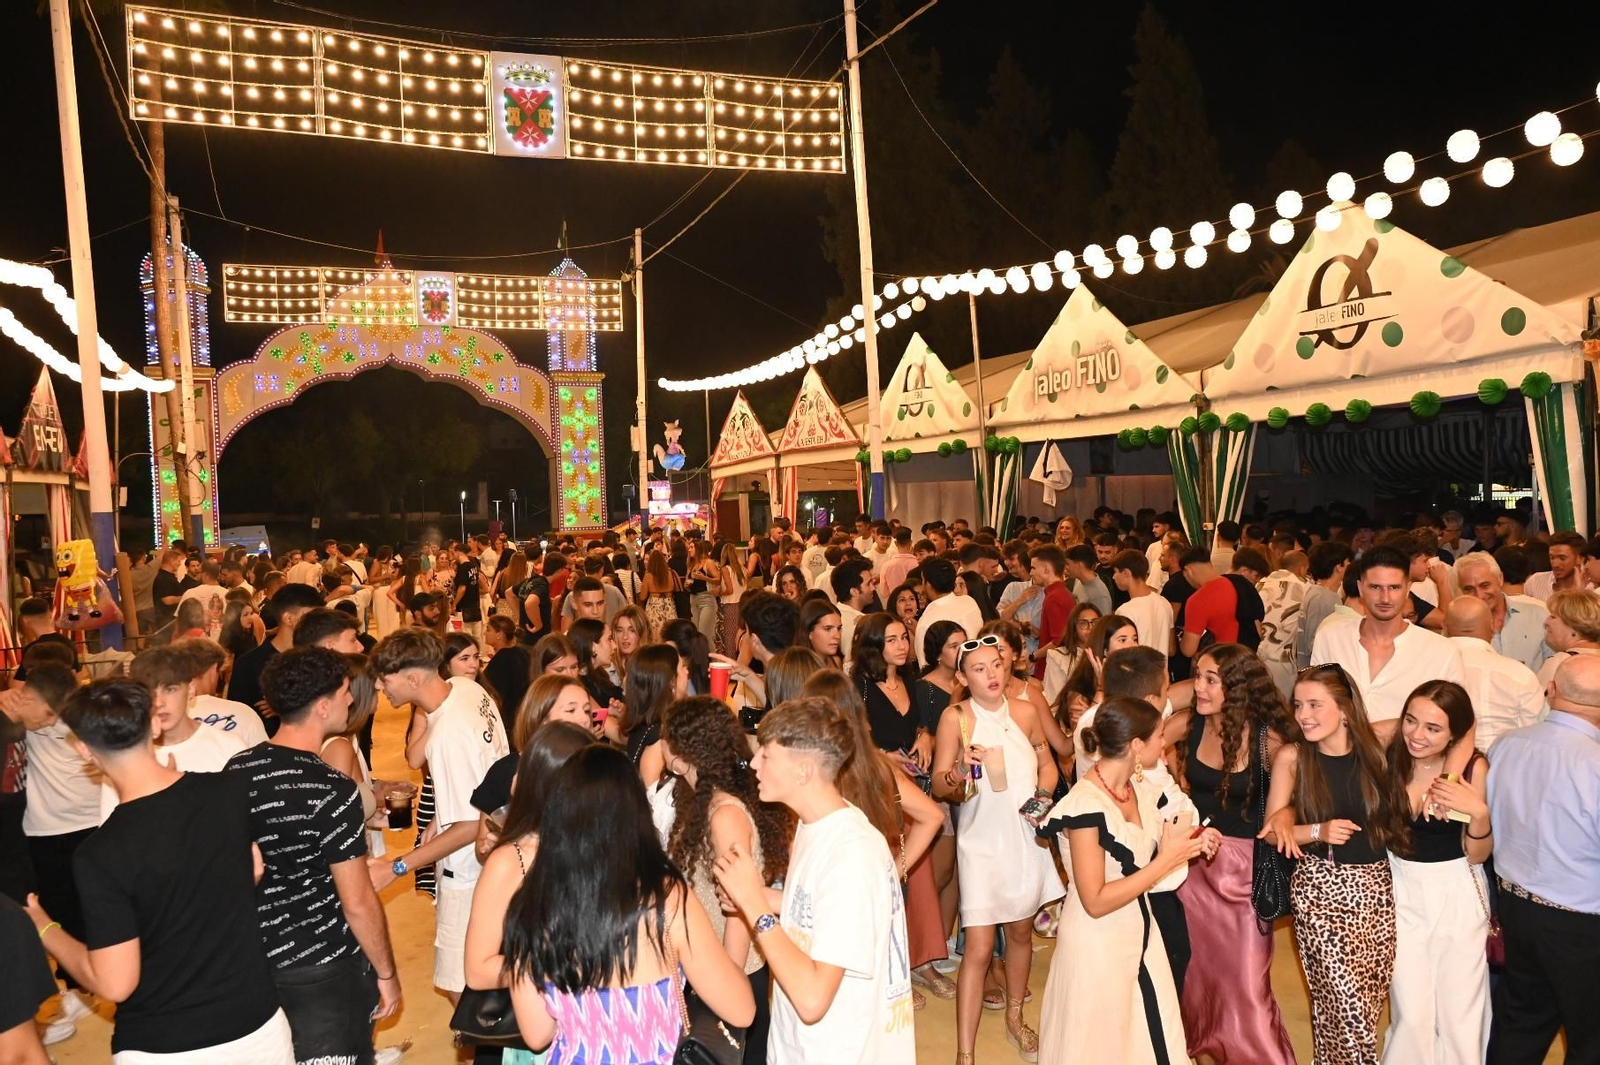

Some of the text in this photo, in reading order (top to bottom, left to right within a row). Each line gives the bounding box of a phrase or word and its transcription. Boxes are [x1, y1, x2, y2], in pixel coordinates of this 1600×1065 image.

[1342, 302, 1365, 319] FINO
[1034, 348, 1120, 405] jaleo FINO
[267, 769, 303, 778] LAGERFELD
[293, 782, 332, 790] LAGERFELD
[331, 804, 348, 818] KARL
